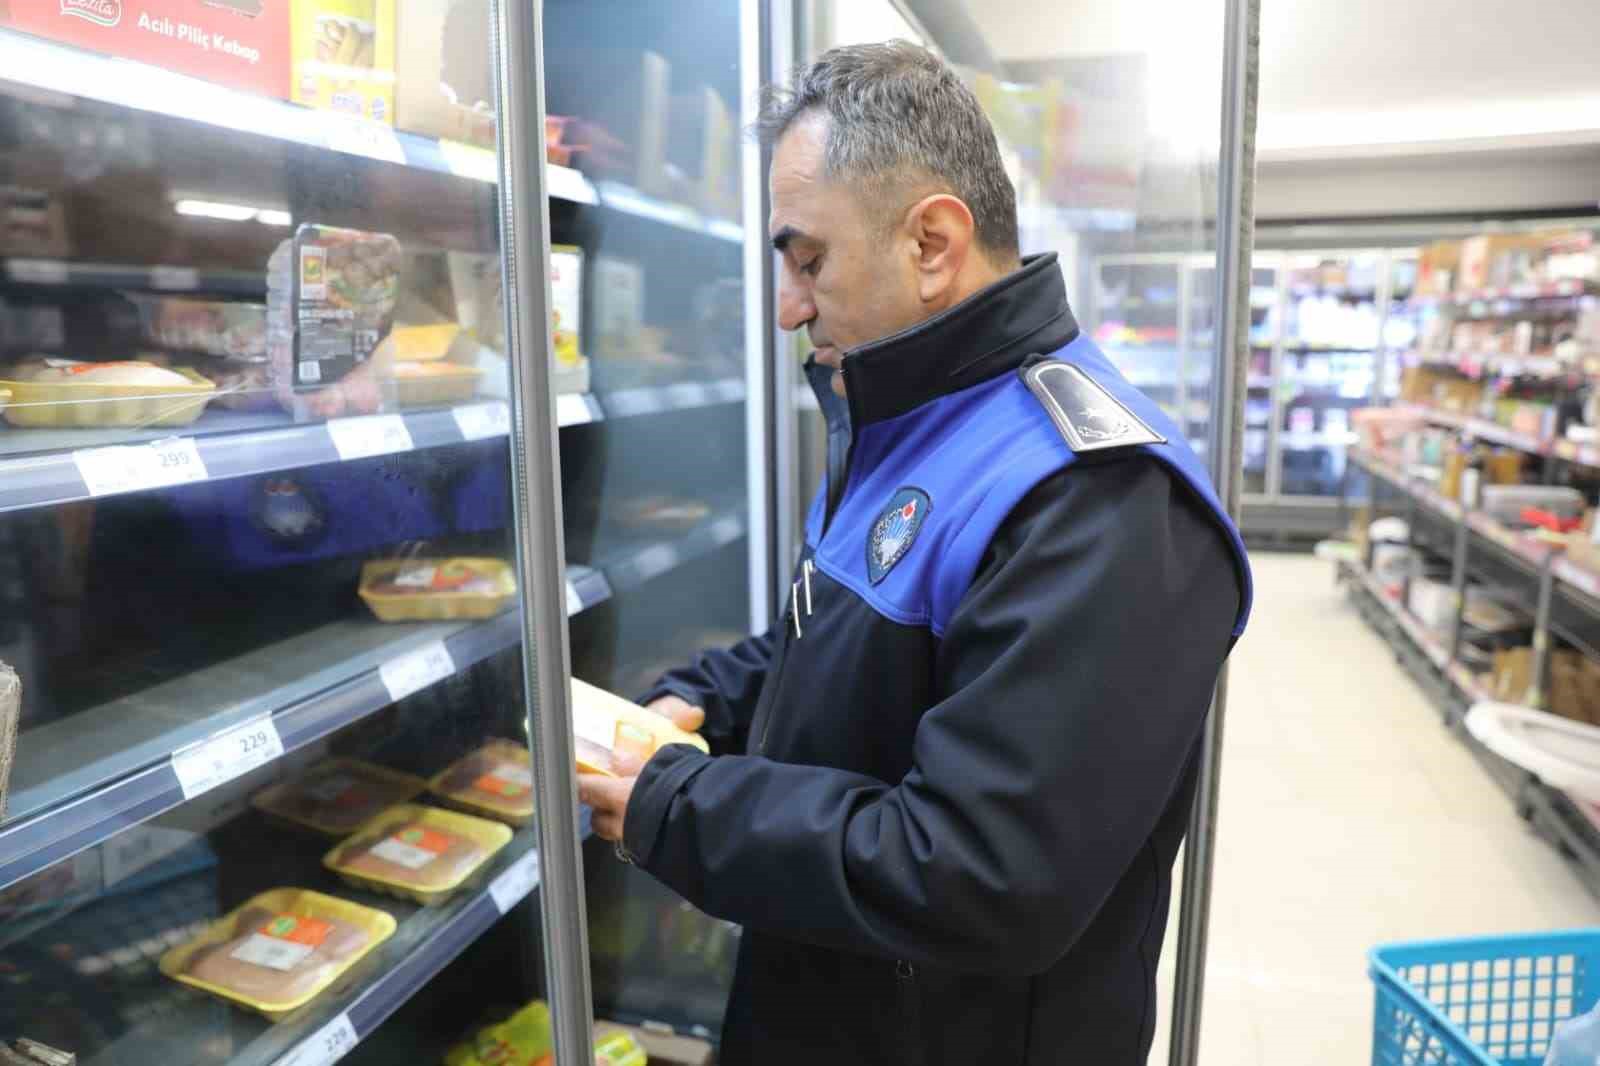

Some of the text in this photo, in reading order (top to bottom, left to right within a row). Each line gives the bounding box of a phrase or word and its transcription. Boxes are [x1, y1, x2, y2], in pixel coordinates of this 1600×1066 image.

[177, 23, 210, 49] Piliç
[212, 34, 260, 63] Kebap
[240, 731, 267, 753] 229
